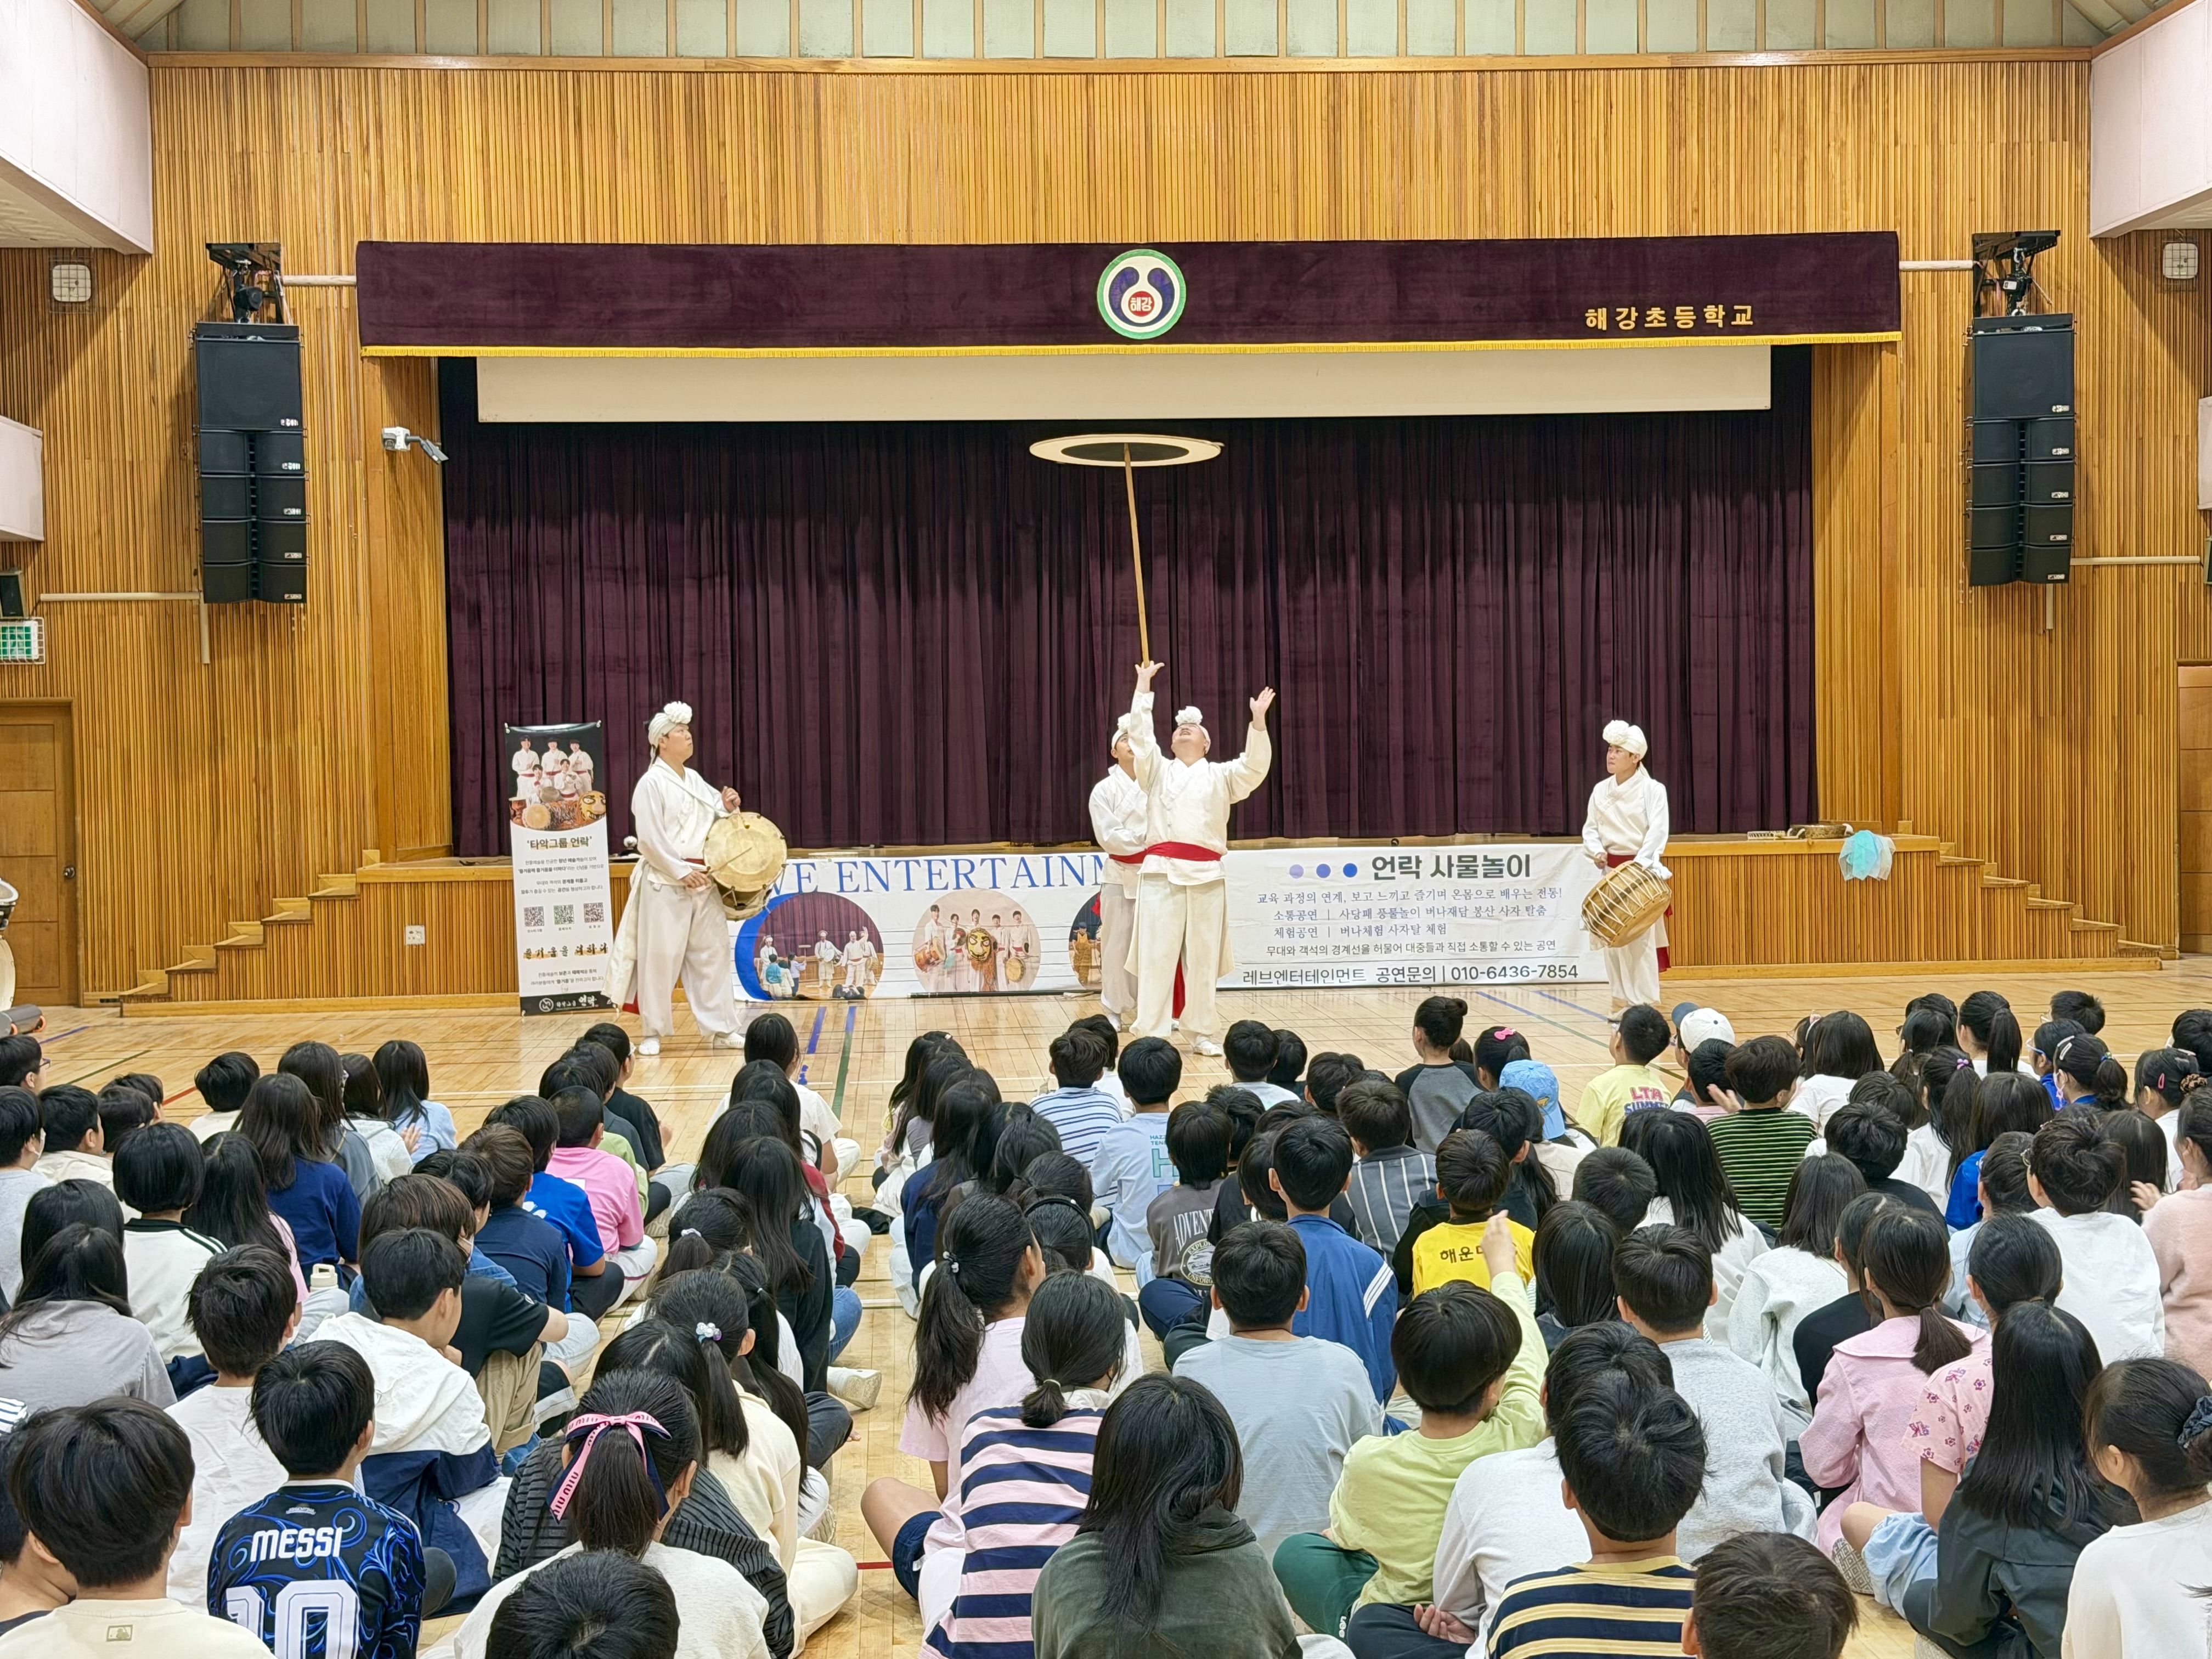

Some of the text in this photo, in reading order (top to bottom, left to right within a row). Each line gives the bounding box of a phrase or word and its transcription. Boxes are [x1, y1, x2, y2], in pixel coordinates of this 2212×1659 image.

[1130, 297, 1153, 312] 해강
[1585, 304, 1753, 331] 해강초등학교
[1372, 854, 1530, 880] 언락 사물놀이
[1257, 893, 1279, 904] 교육
[1283, 891, 1316, 904] 과정의
[1351, 891, 1374, 902] 보고
[1377, 889, 1410, 901] 느끼고
[1414, 889, 1447, 901] 즐기며
[1451, 889, 1496, 900] 온몸으로
[1500, 888, 1533, 900] 배우는
[1537, 887, 1562, 899] 전통!
[1273, 904, 1547, 921] 소통공연 사당패 풍물놀이 버나재담 봉산 사자 탈춤
[1274, 923, 1446, 939] 체험공연 버나체험 사자탈 체험
[1266, 940, 1555, 956] 무대와 객석의 경계선을 허물어 대중들과 직접 소통할 수 있는 공연
[1243, 964, 1578, 986] 레브엔터테인먼트 공연문의 010-6436-7854
[250, 1527, 343, 1563] MESSI
